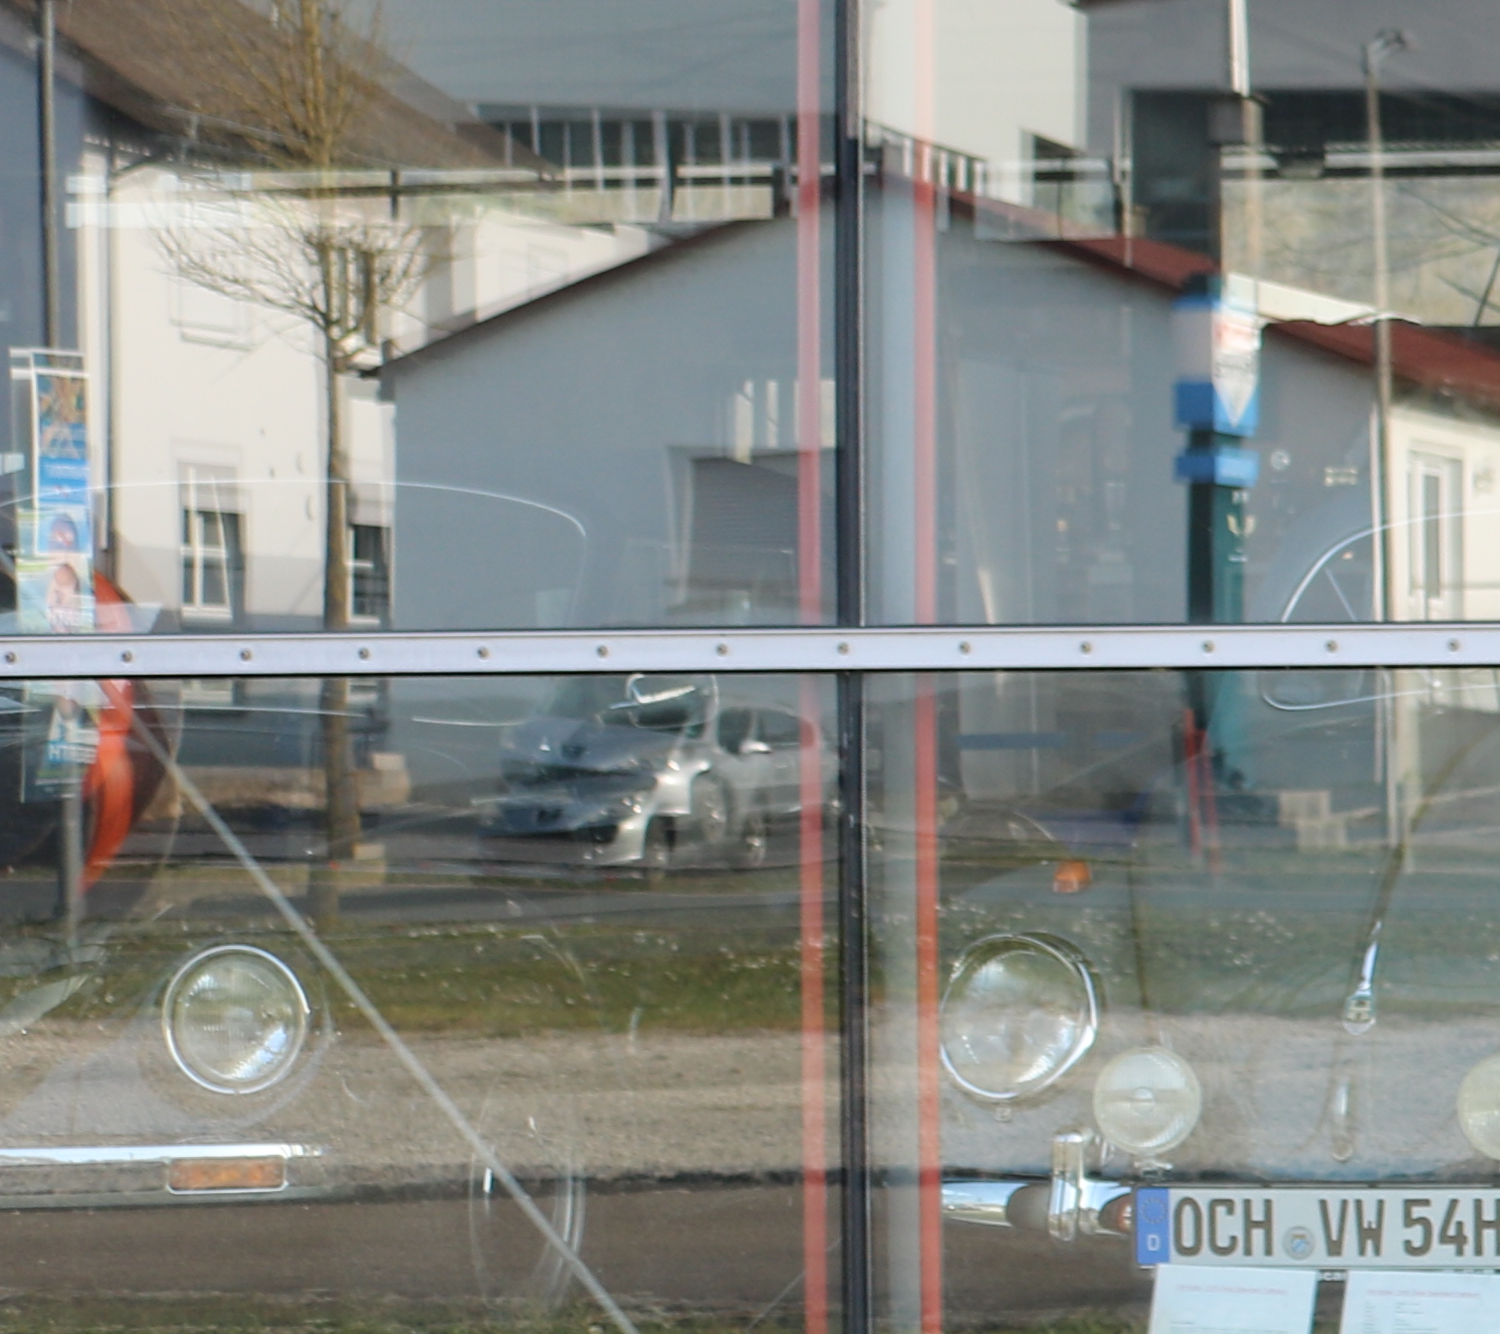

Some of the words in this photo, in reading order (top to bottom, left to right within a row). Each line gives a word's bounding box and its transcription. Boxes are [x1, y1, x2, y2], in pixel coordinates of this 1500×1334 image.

[1146, 1233, 1160, 1252] D
[1173, 1196, 1274, 1258] OCH
[1318, 1197, 1387, 1258] VW
